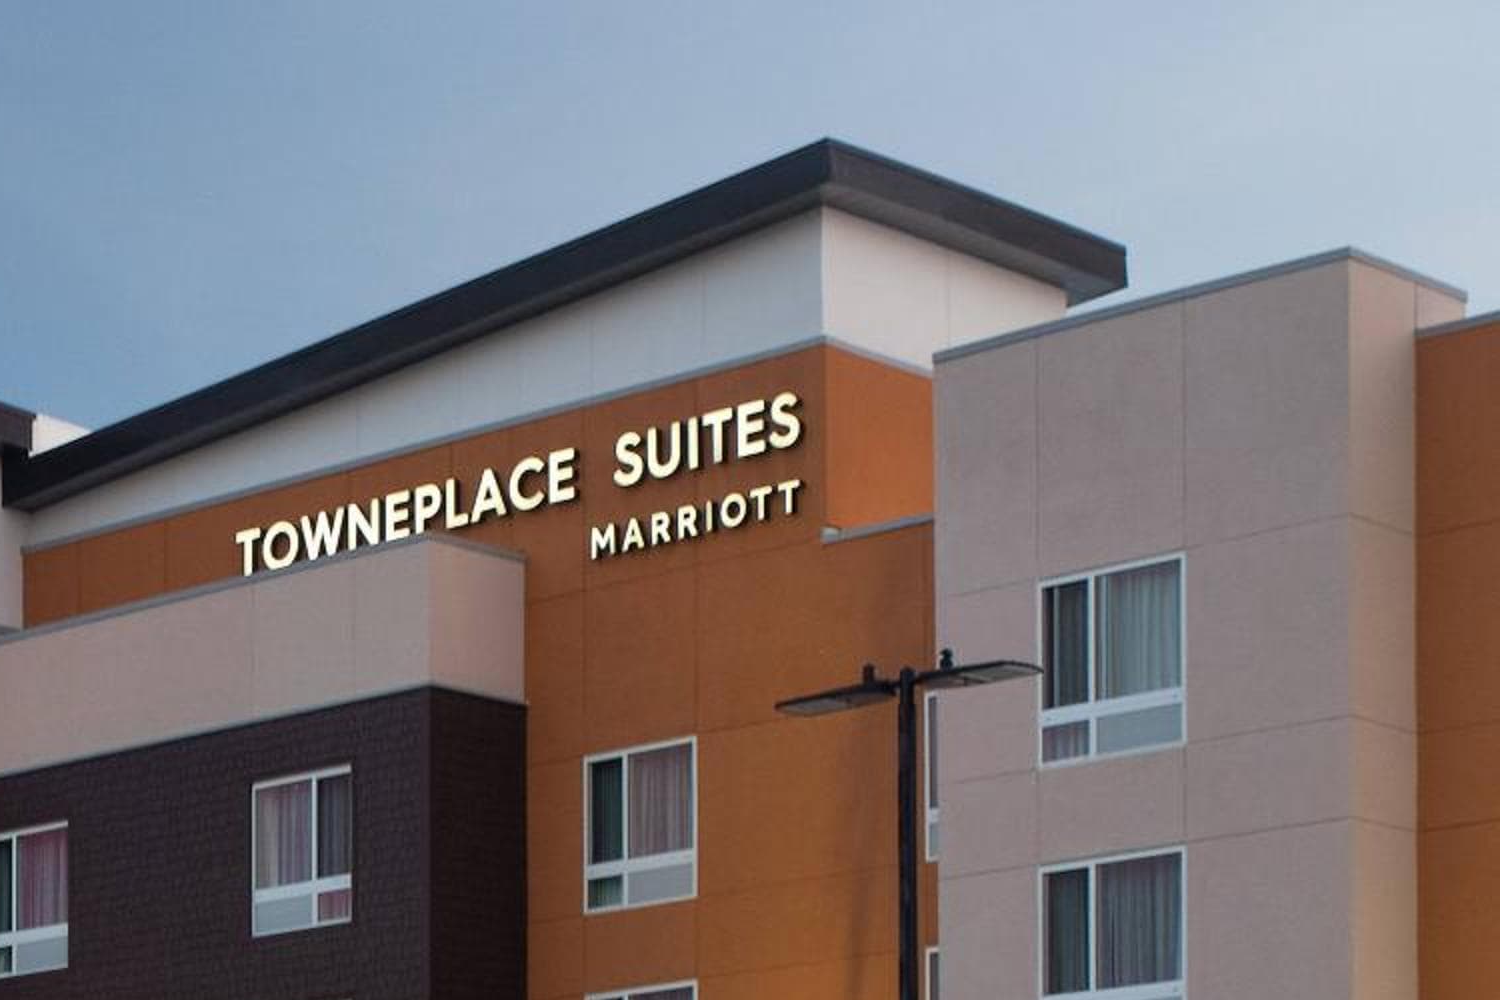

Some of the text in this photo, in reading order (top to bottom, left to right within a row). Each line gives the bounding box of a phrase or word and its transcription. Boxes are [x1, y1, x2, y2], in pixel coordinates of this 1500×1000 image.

[235, 392, 801, 577] TOWNEPLACE SUITES
[590, 479, 801, 561] MARRIOTT
